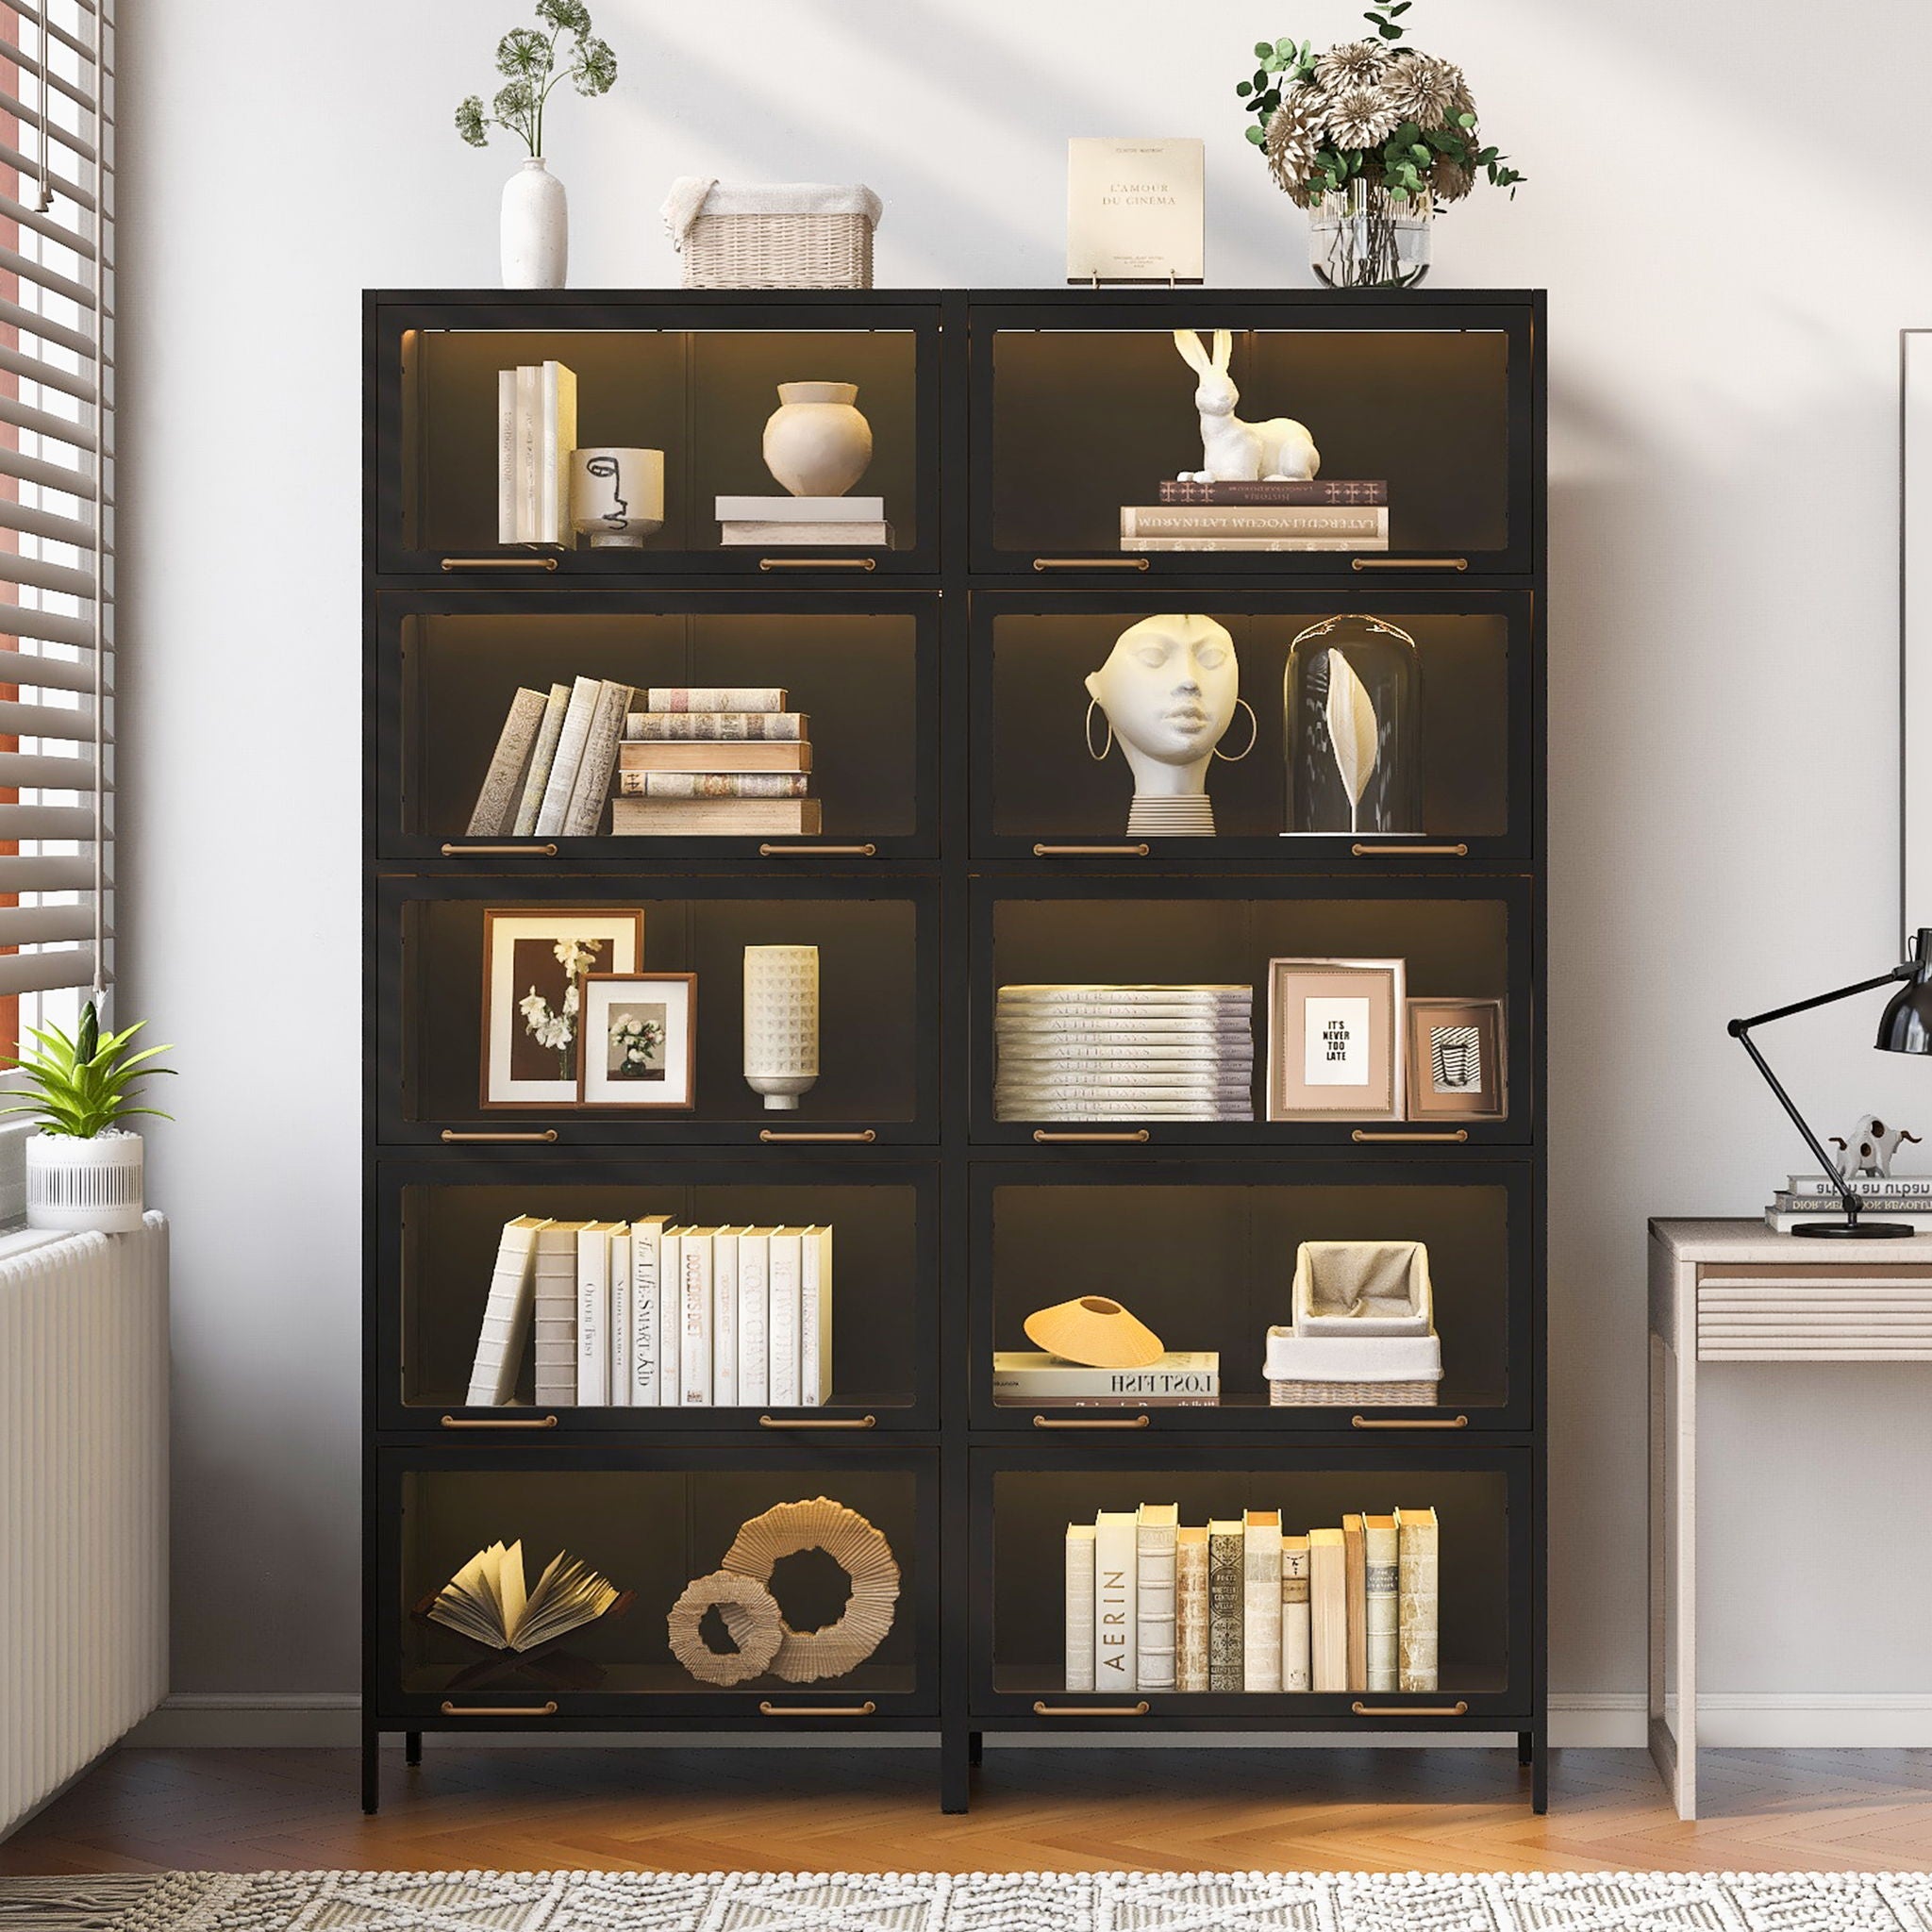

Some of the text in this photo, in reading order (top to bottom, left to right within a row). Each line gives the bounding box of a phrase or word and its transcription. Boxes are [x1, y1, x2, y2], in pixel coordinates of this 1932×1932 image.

[1110, 184, 1169, 192] L'AMOUR
[1102, 196, 1121, 205] DU
[1138, 518, 1227, 528] LATINARUM
[1232, 518, 1291, 528] VOCUM
[1323, 1031, 1350, 1040] NEVER
[1327, 1041, 1345, 1050] TOO
[1326, 1052, 1346, 1060] LATE
[584, 1283, 596, 1357] OLIVER TWIST
[686, 1313, 703, 1340] DIET
[1103, 1572, 1124, 1672] AERIN
